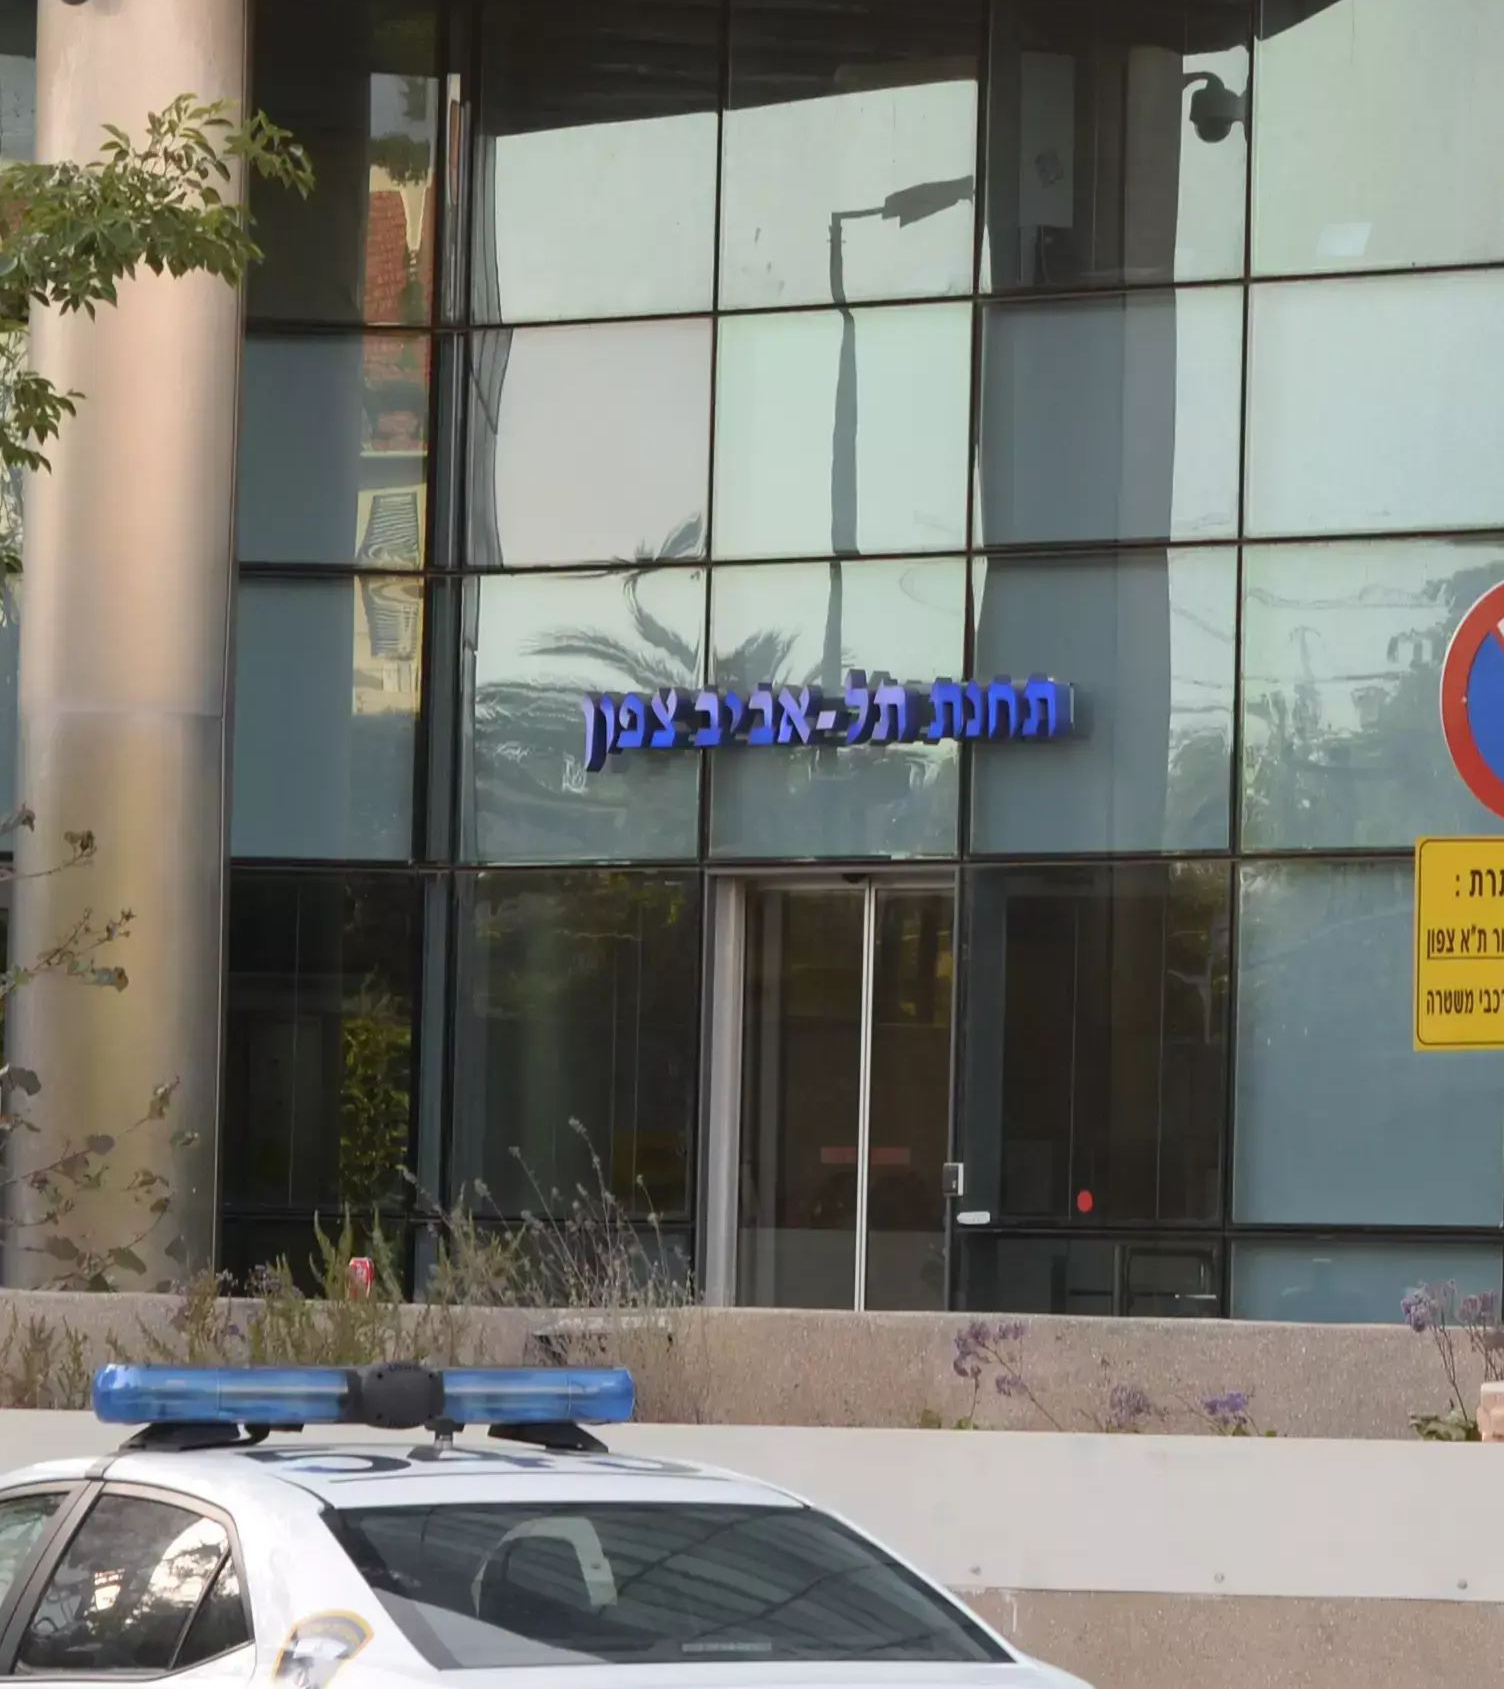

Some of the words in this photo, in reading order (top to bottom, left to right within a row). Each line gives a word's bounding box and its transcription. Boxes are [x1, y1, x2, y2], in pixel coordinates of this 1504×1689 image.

[583, 688, 682, 772] צפון
[927, 673, 1062, 742] תחנת
[1426, 927, 1456, 959] צפון
[1426, 988, 1474, 1015] משטרה
